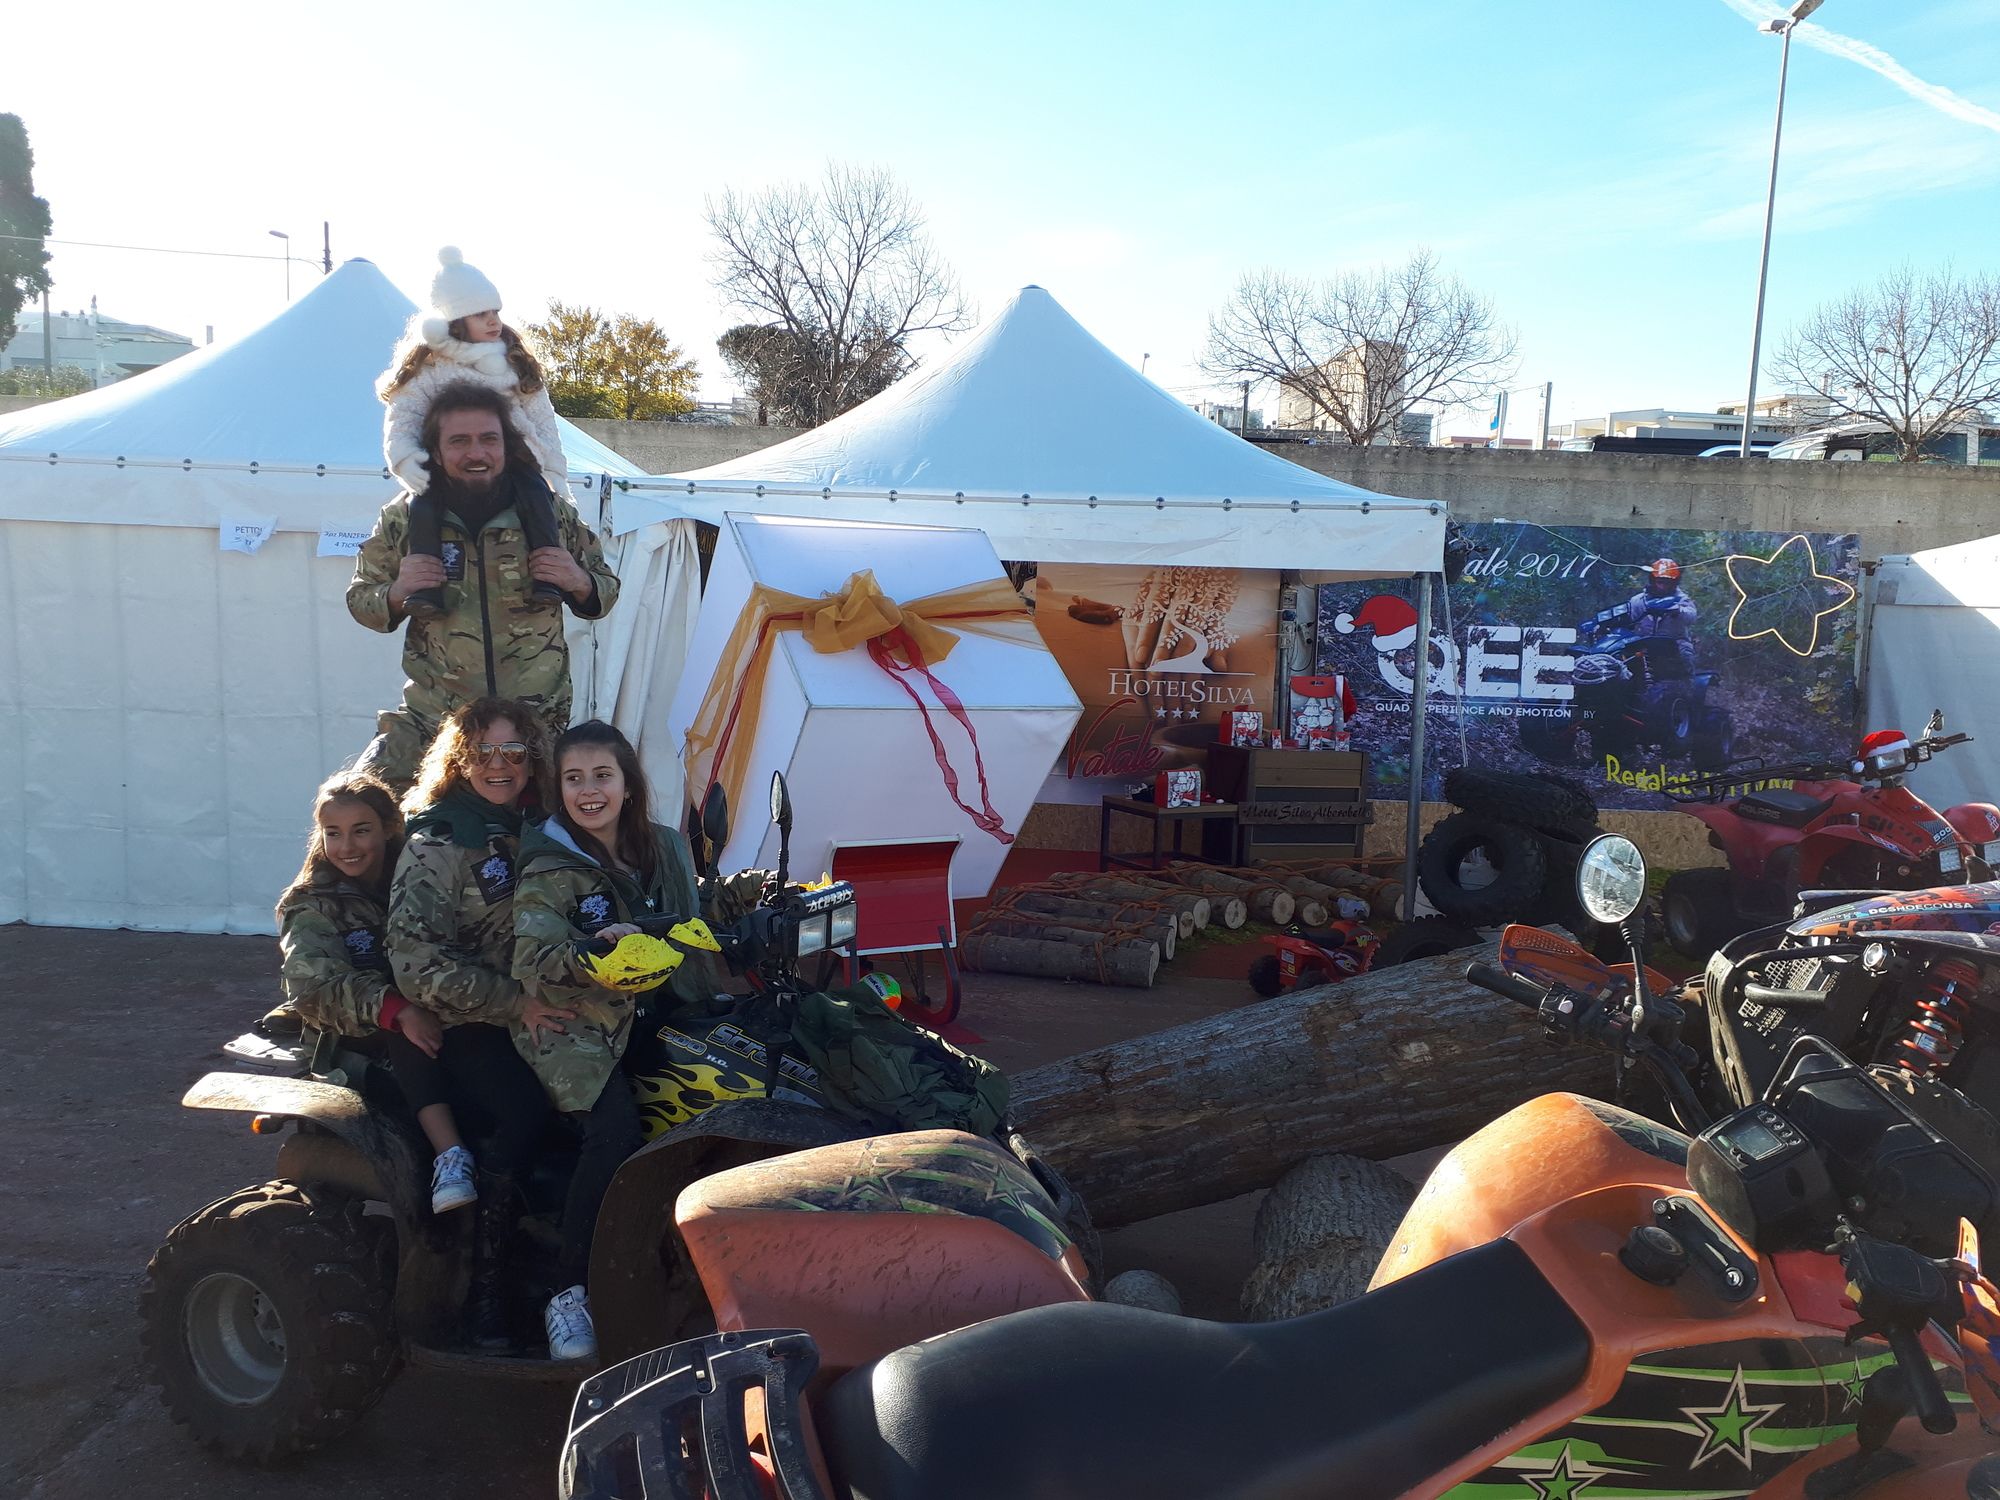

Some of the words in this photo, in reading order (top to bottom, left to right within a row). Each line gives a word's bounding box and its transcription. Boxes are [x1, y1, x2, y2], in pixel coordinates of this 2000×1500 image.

[1514, 553, 1601, 578] 2017
[1378, 626, 1577, 700] QEE
[1375, 702, 1410, 713] QUAD
[1424, 704, 1485, 715] XPERINCE
[1488, 706, 1513, 717] AND
[1515, 707, 1572, 719] EMOTION
[1583, 710, 1597, 719] BY
[1932, 827, 1953, 843] 500
[657, 1026, 708, 1056] 500
